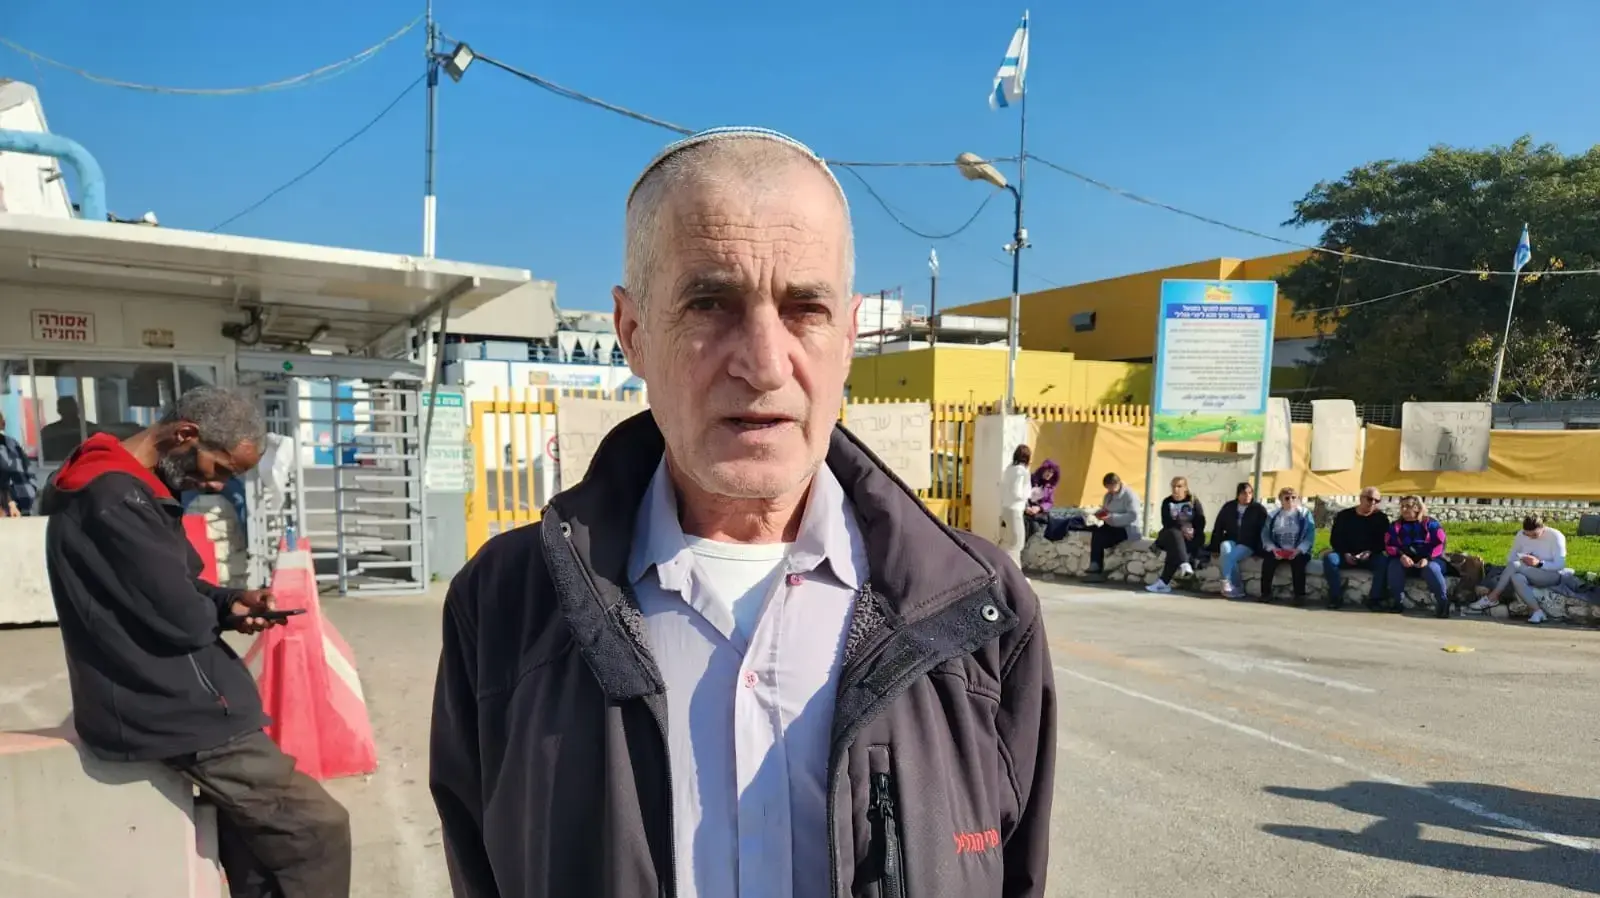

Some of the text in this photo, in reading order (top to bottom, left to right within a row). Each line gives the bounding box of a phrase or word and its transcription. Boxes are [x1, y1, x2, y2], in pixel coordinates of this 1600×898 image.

[38, 314, 88, 327] אסורה
[42, 327, 87, 341] החניה
[952, 828, 999, 853] פרי הגליל
